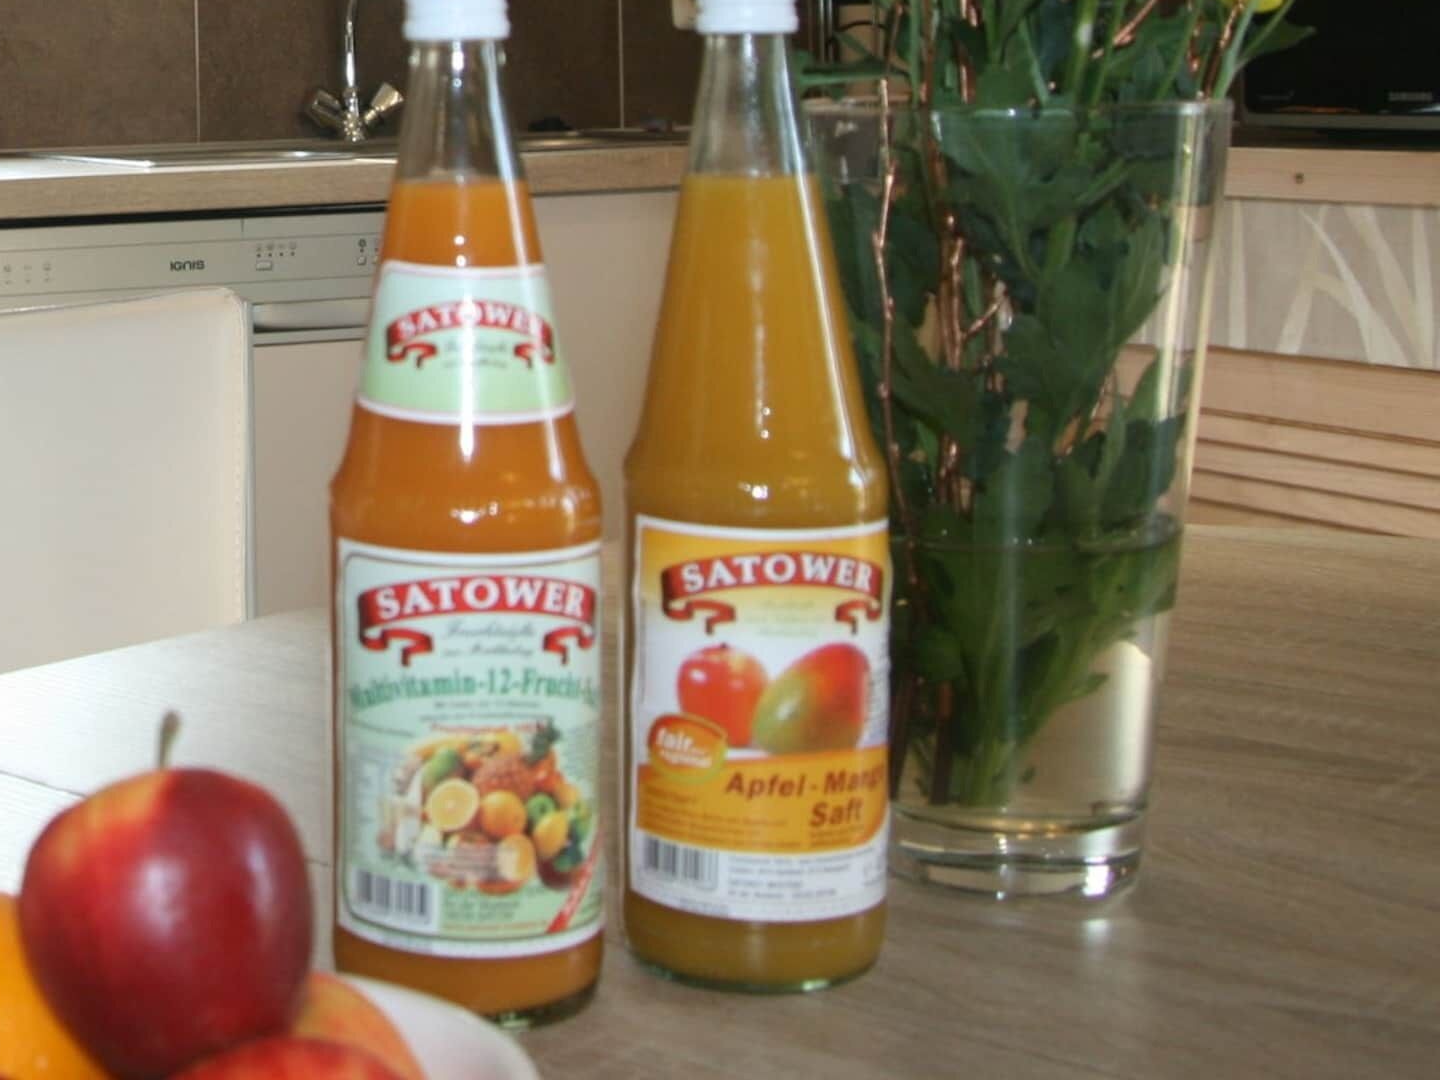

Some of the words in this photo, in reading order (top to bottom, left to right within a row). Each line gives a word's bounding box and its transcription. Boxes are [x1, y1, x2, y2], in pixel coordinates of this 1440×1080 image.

[169, 259, 206, 272] IGNIS
[682, 553, 873, 593] SATOWER
[375, 577, 585, 620] SATOWER
[810, 797, 864, 827] Saft
